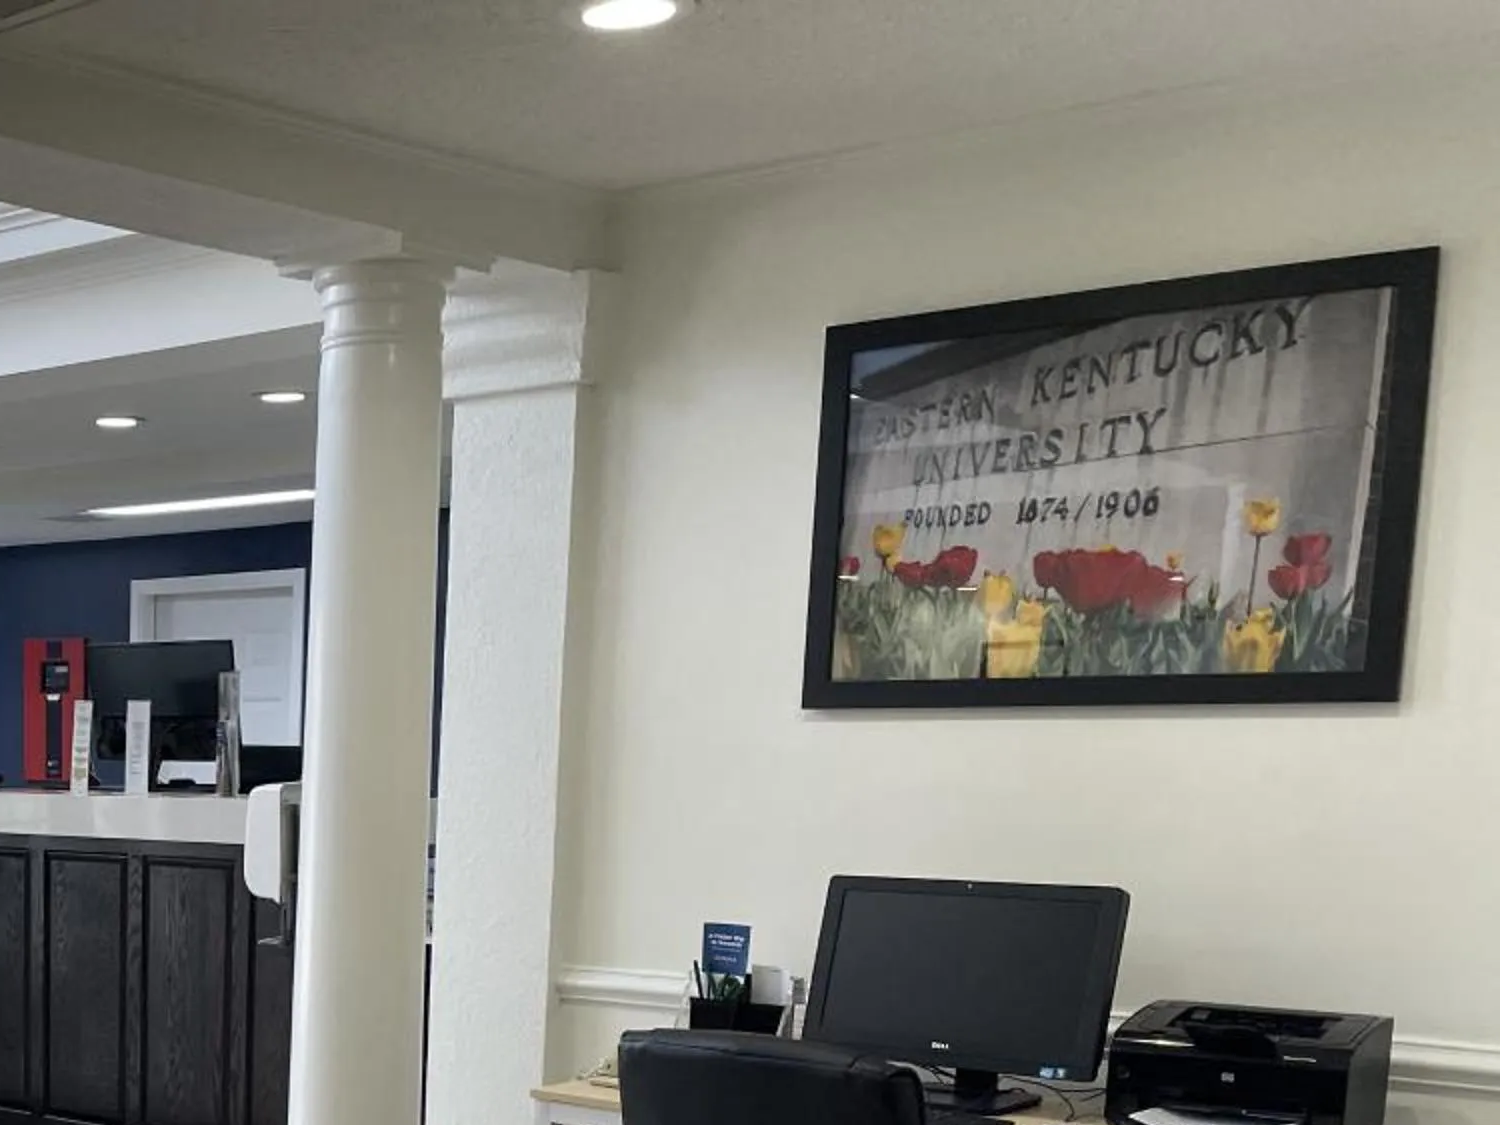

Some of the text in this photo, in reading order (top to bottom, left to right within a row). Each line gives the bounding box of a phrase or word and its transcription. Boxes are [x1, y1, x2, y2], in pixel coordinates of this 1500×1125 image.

[875, 297, 1312, 443] EASTERN KENTUCKY
[912, 406, 1168, 486] UNIVERSITY
[904, 501, 992, 530] FOUNDED
